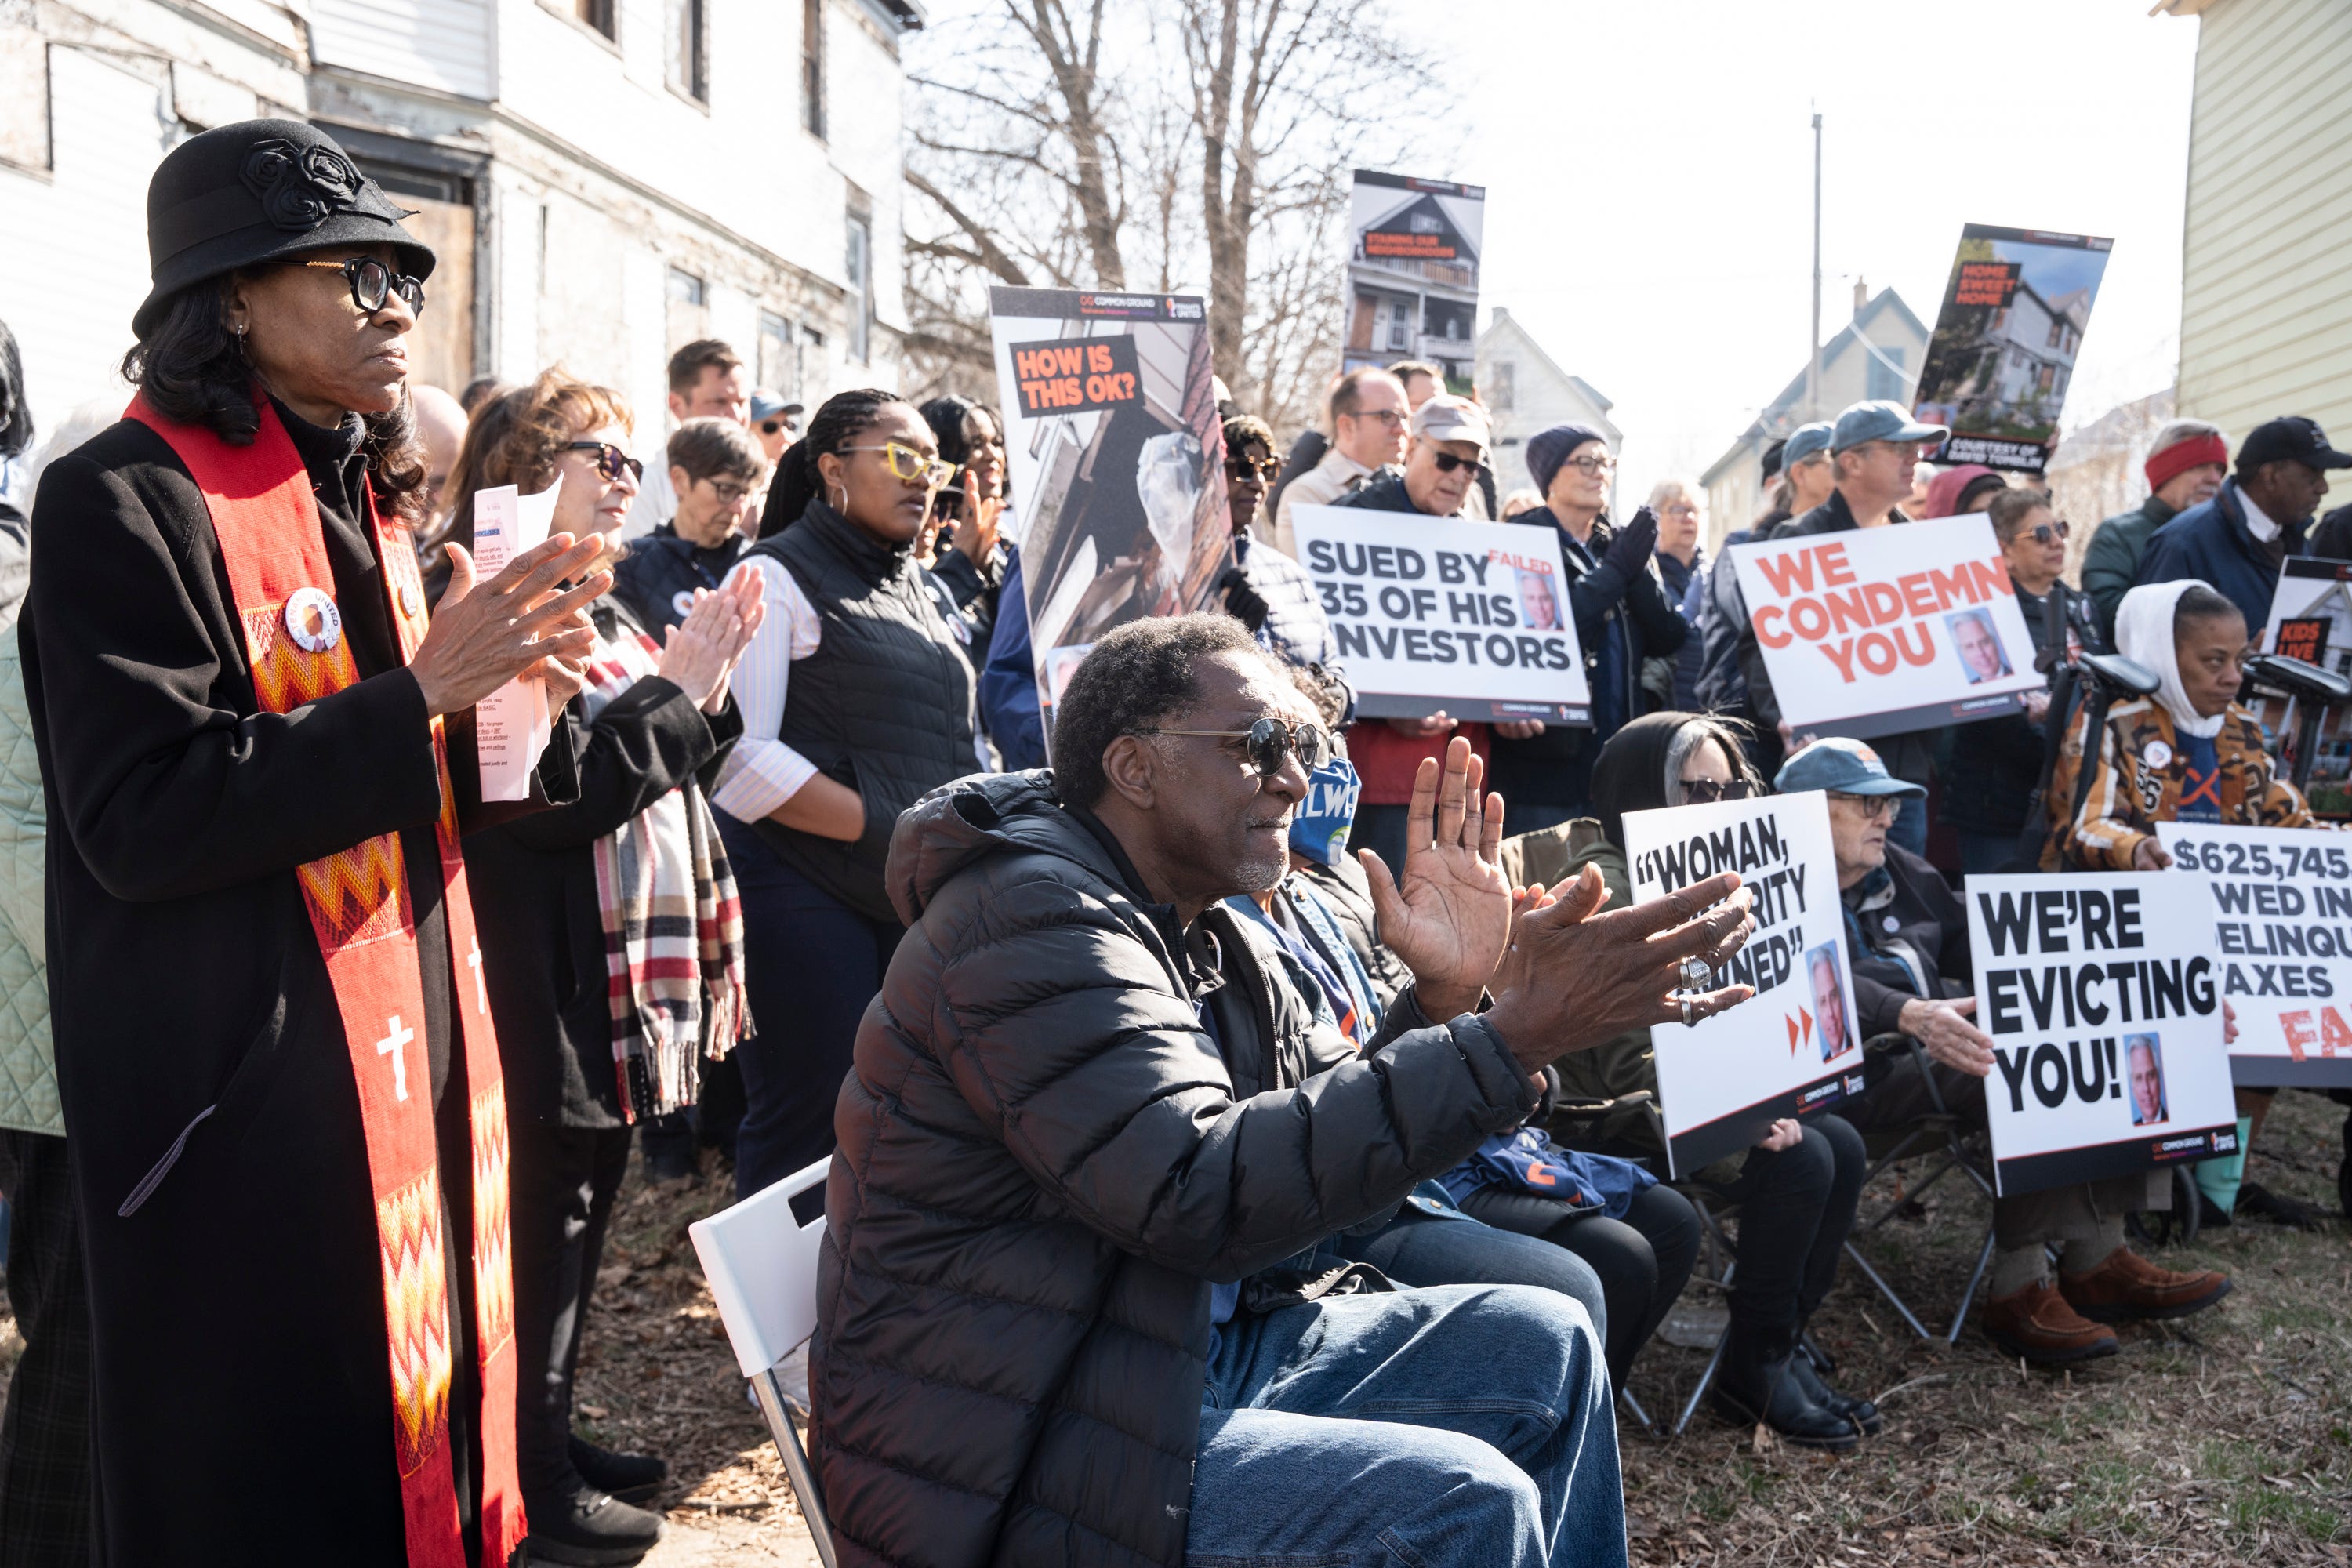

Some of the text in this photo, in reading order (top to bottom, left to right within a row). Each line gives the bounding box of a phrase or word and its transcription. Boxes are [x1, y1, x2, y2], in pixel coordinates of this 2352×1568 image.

[1094, 296, 1124, 307] COMMON
[1126, 297, 1156, 308] GROUND
[1959, 278, 2016, 292] SWEET
[1017, 345, 1114, 379] HOW IS
[1022, 372, 1136, 409] THIS OK?
[1947, 449, 1987, 463] DAVID
[1951, 438, 2040, 456] COURTESY OF
[1308, 539, 1554, 586] SUED BY FAILED
[1755, 542, 1857, 597] WE
[314, 593, 339, 627] UNITED
[1315, 581, 1517, 628] 35 OF HIS
[1752, 556, 2016, 650] CONDEMN
[1329, 622, 1571, 671] NVESTORS
[2281, 622, 2321, 642] KIDS
[1817, 621, 1936, 684] YOU
[1635, 813, 1788, 894] “WOMAN,
[2173, 838, 2352, 882] $625,745
[2211, 882, 2352, 918] WED IN
[2214, 922, 2352, 959] ELINQU
[1985, 956, 2216, 1034] EVICTING
[2218, 962, 2333, 998] AXES
[2278, 1004, 2352, 1063] FA
[1994, 1036, 2122, 1112] YOU!
